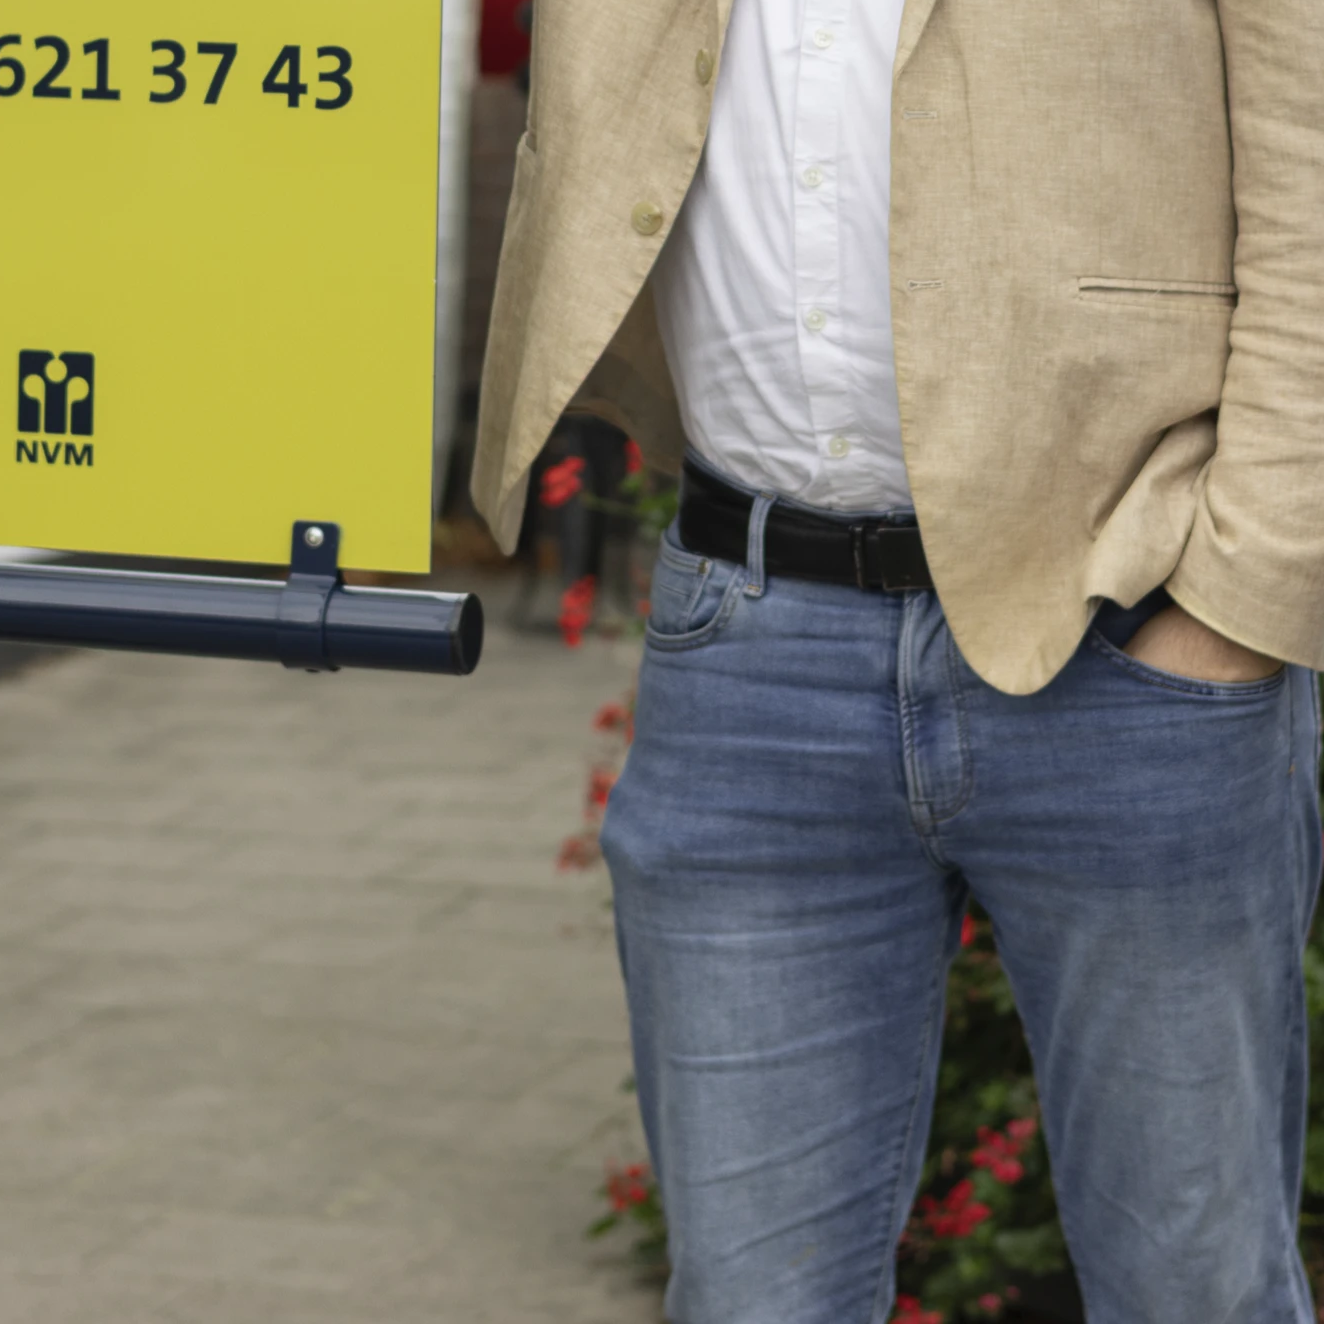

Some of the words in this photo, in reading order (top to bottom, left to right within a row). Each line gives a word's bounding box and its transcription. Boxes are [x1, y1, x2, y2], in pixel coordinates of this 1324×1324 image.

[147, 38, 239, 106] 37
[260, 43, 355, 111] 43
[15, 438, 95, 467] NVM
